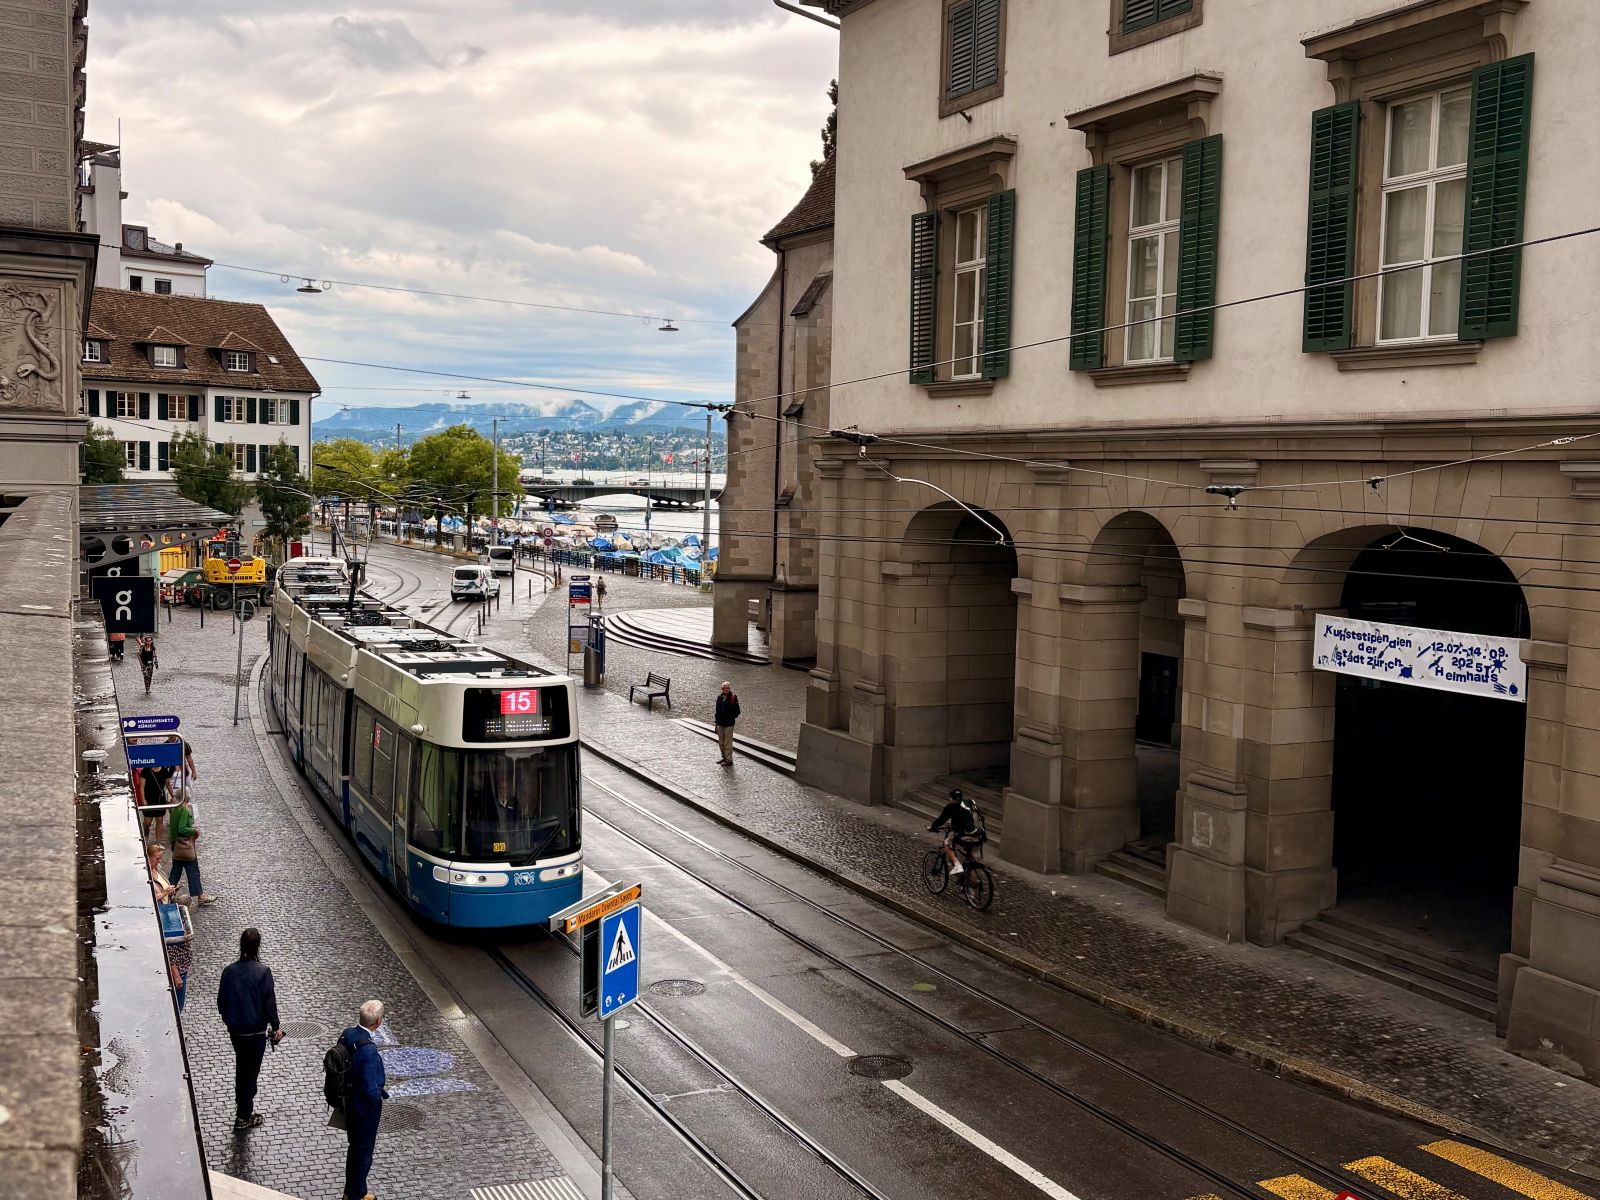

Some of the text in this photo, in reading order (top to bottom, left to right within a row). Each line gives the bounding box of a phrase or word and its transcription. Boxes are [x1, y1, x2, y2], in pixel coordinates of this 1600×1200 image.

[1325, 625, 1412, 649] Kunststipendien
[1358, 642, 1377, 654] der
[1451, 657, 1483, 673] 2025
[1435, 667, 1498, 683] Helmhaus
[506, 691, 531, 711] 15
[578, 907, 600, 924] Mandarin
[601, 897, 619, 913] Oriental
